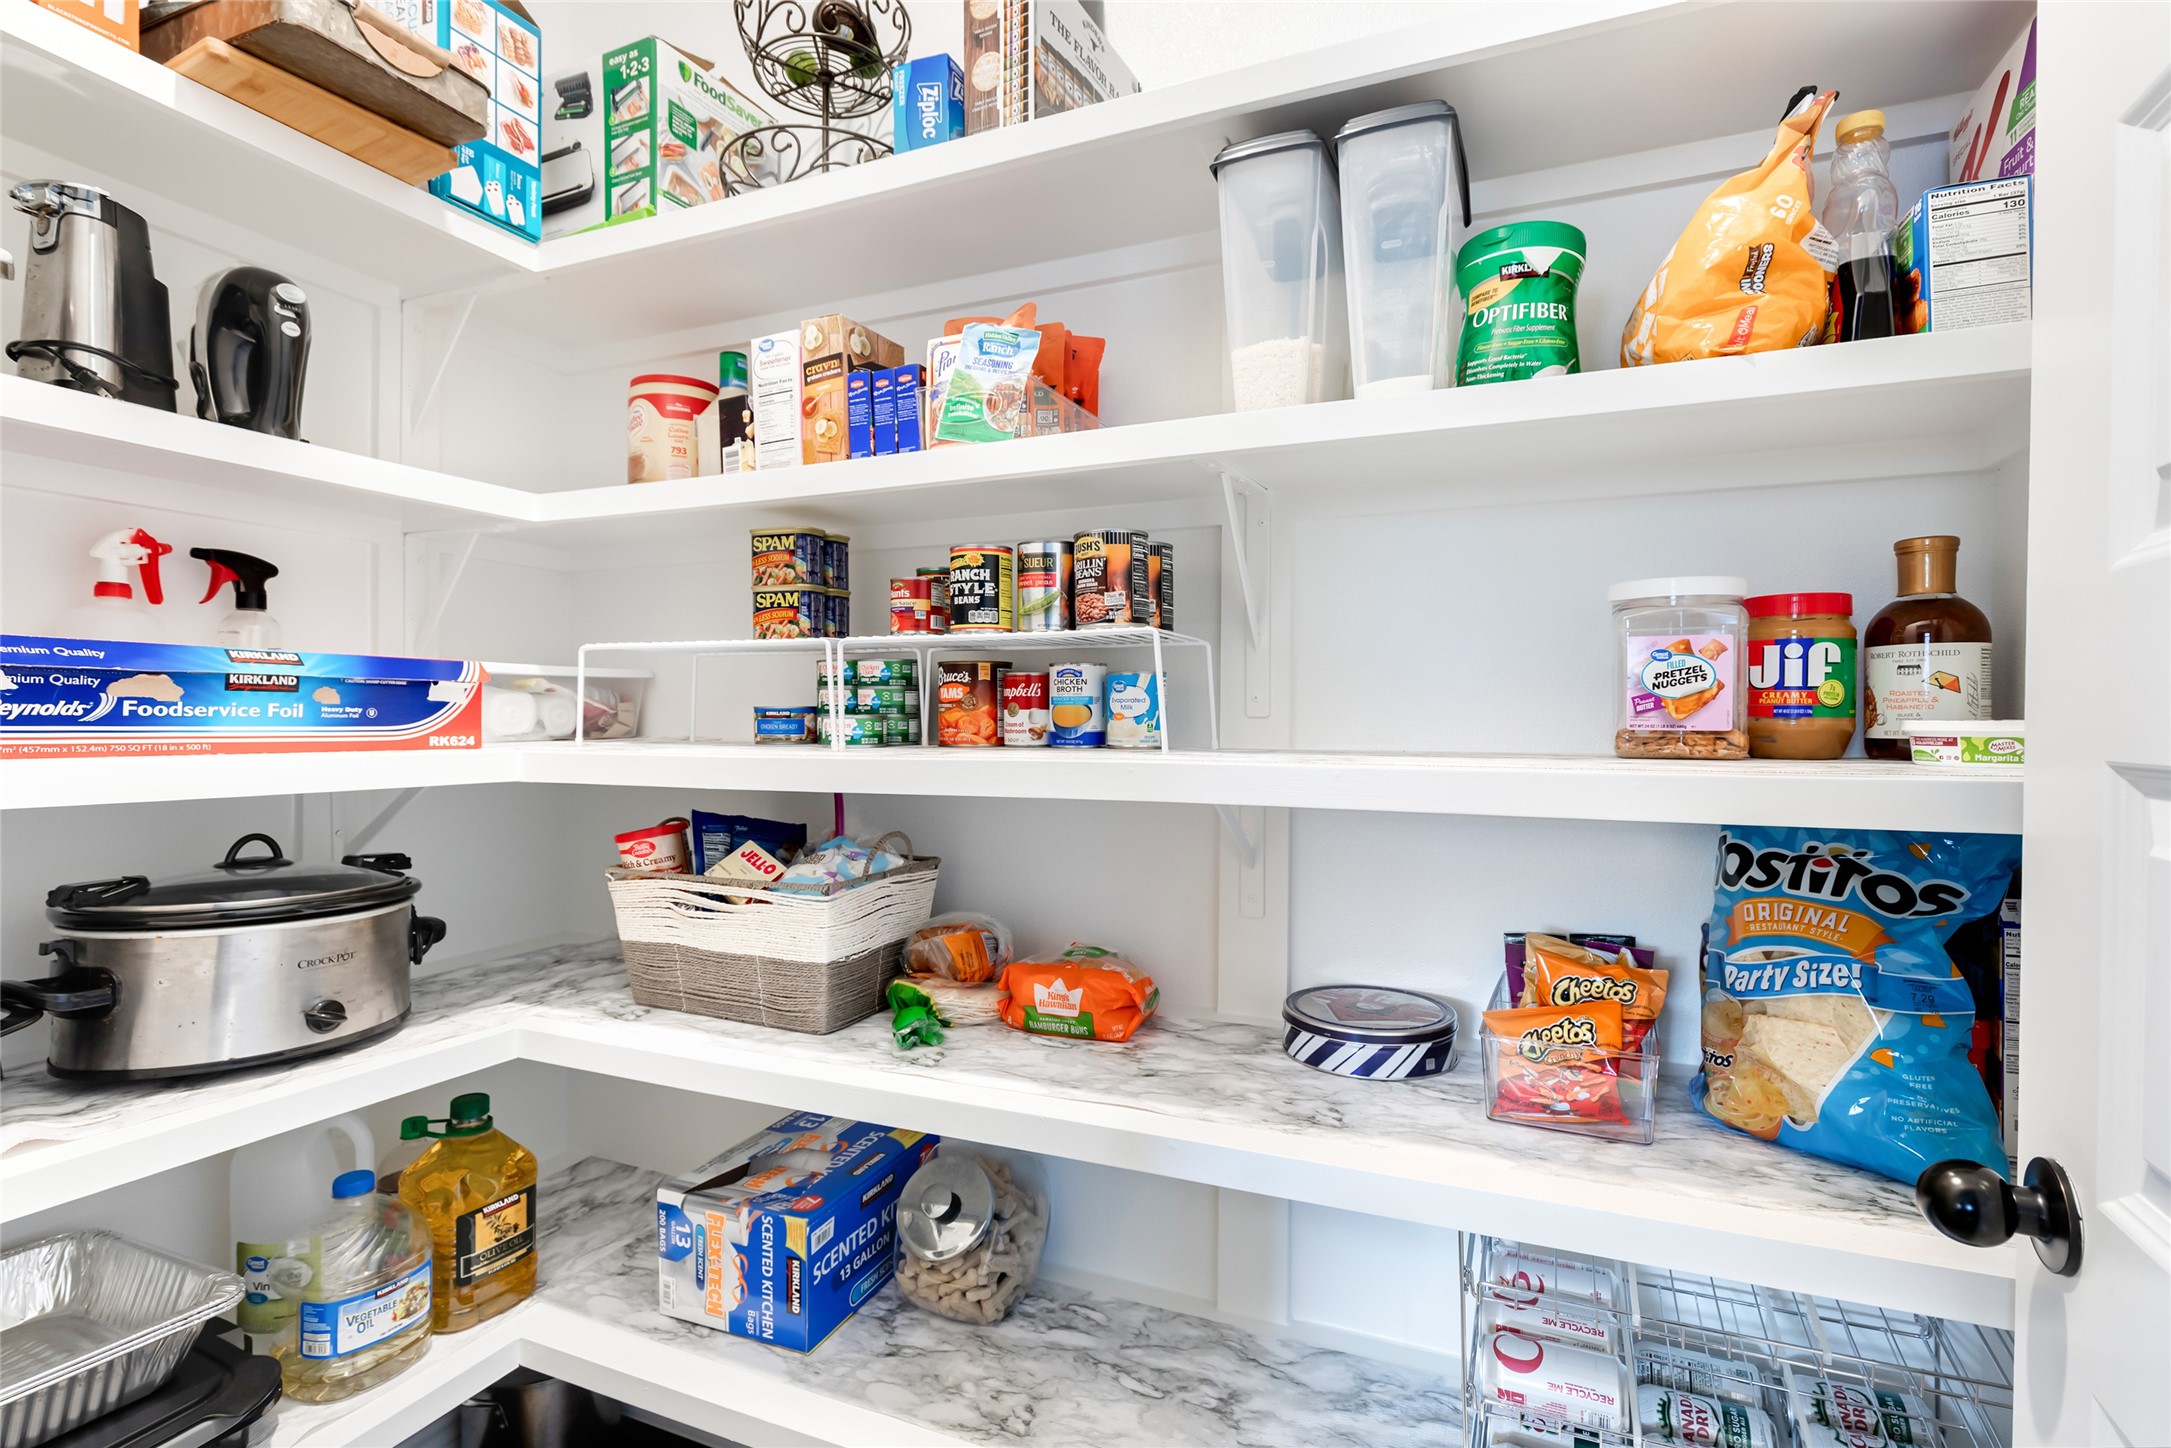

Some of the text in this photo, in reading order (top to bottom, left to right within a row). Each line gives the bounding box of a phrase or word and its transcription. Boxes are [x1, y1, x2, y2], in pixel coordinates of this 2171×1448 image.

[1050, 10, 1107, 87] THE FLAVOR
[609, 49, 638, 66] easy as
[694, 71, 763, 127] FoodSaver
[917, 85, 939, 139] Ziploc
[2004, 137, 2034, 175] Fruit &
[1931, 179, 2025, 199] Nutrition Facts
[1770, 194, 1793, 219] 60
[2003, 199, 2026, 209] 130
[1932, 210, 1970, 220] Calories
[1472, 302, 1568, 328] OPTIFIBER
[983, 342, 1014, 355] Ranch
[973, 357, 1014, 369] SEASONING
[671, 446, 687, 455] 793
[753, 535, 795, 552] SPAM
[1024, 557, 1053, 568] SUEUR
[951, 569, 990, 581] RANCH
[950, 582, 996, 596] STYLE
[756, 592, 799, 608] SPAM
[954, 596, 980, 605] BEANS
[0, 645, 105, 659] emium Quality
[228, 650, 299, 663] KIRKLAND
[1870, 651, 1895, 660] ROBERT
[1667, 660, 1686, 669] FILLED
[1750, 642, 1842, 688] Jif
[8, 674, 101, 688] mium Quality
[229, 674, 297, 685] KIRKLAND
[939, 666, 971, 686] Bruce's
[1653, 665, 1706, 681] PRETZEL
[1053, 678, 1087, 686] CHICKEN
[1652, 673, 1707, 690] NUGGETS
[940, 687, 963, 699] YAMS
[122, 700, 304, 718] Foodservice Foil
[321, 706, 343, 714] Heavy
[1636, 702, 1655, 712] BUTTER
[19, 745, 62, 754] (457mm
[70, 745, 107, 753] 152.4m)
[128, 744, 140, 752] SQ
[154, 744, 168, 752] (18
[202, 743, 211, 751] ft)
[429, 736, 475, 747] RK624
[1991, 741, 2015, 749] MASTER
[1975, 754, 2019, 763] Margarita
[643, 855, 676, 866] Creamy
[1744, 903, 1850, 934] ORIGINAL
[1750, 923, 1841, 942] RESTAURANT STYLE
[1725, 960, 1864, 992] Party Size!
[1048, 991, 1070, 1001] King's
[1552, 976, 1638, 1005] Cheetos
[1039, 999, 1077, 1010] Hawaiian
[1029, 1020, 1088, 1035] HAMBURGER BUNS
[1902, 1073, 1936, 1081] GLUTEN
[1909, 1082, 1932, 1090] FREE
[1904, 1125, 1948, 1134] FLAVORS
[1908, 1117, 1959, 1127] ARTIFICIAL
[862, 1173, 894, 1203] KIRKLAND
[483, 1194, 519, 1214] KIRKLAND
[676, 1224, 691, 1249] 13
[480, 1243, 508, 1261] OLIVE
[509, 1235, 524, 1247] OIL
[813, 1217, 878, 1286] SCENTED
[840, 1231, 891, 1281] 13 GALLON
[705, 1211, 726, 1318] FLEX-TECH
[761, 1215, 774, 1339] SCENTED KITCHEN
[376, 1278, 409, 1296] KIRKLAND
[791, 1260, 800, 1314] KIRKLAND
[346, 1300, 398, 1327] VEGETABLE
[357, 1320, 375, 1334] OIL
[746, 1310, 756, 1335] Bags
[1542, 1316, 1604, 1338] RECYCLE ME
[1547, 1381, 1614, 1406] RECYCLE ME
[1679, 1393, 1710, 1448] ANADA DRY
